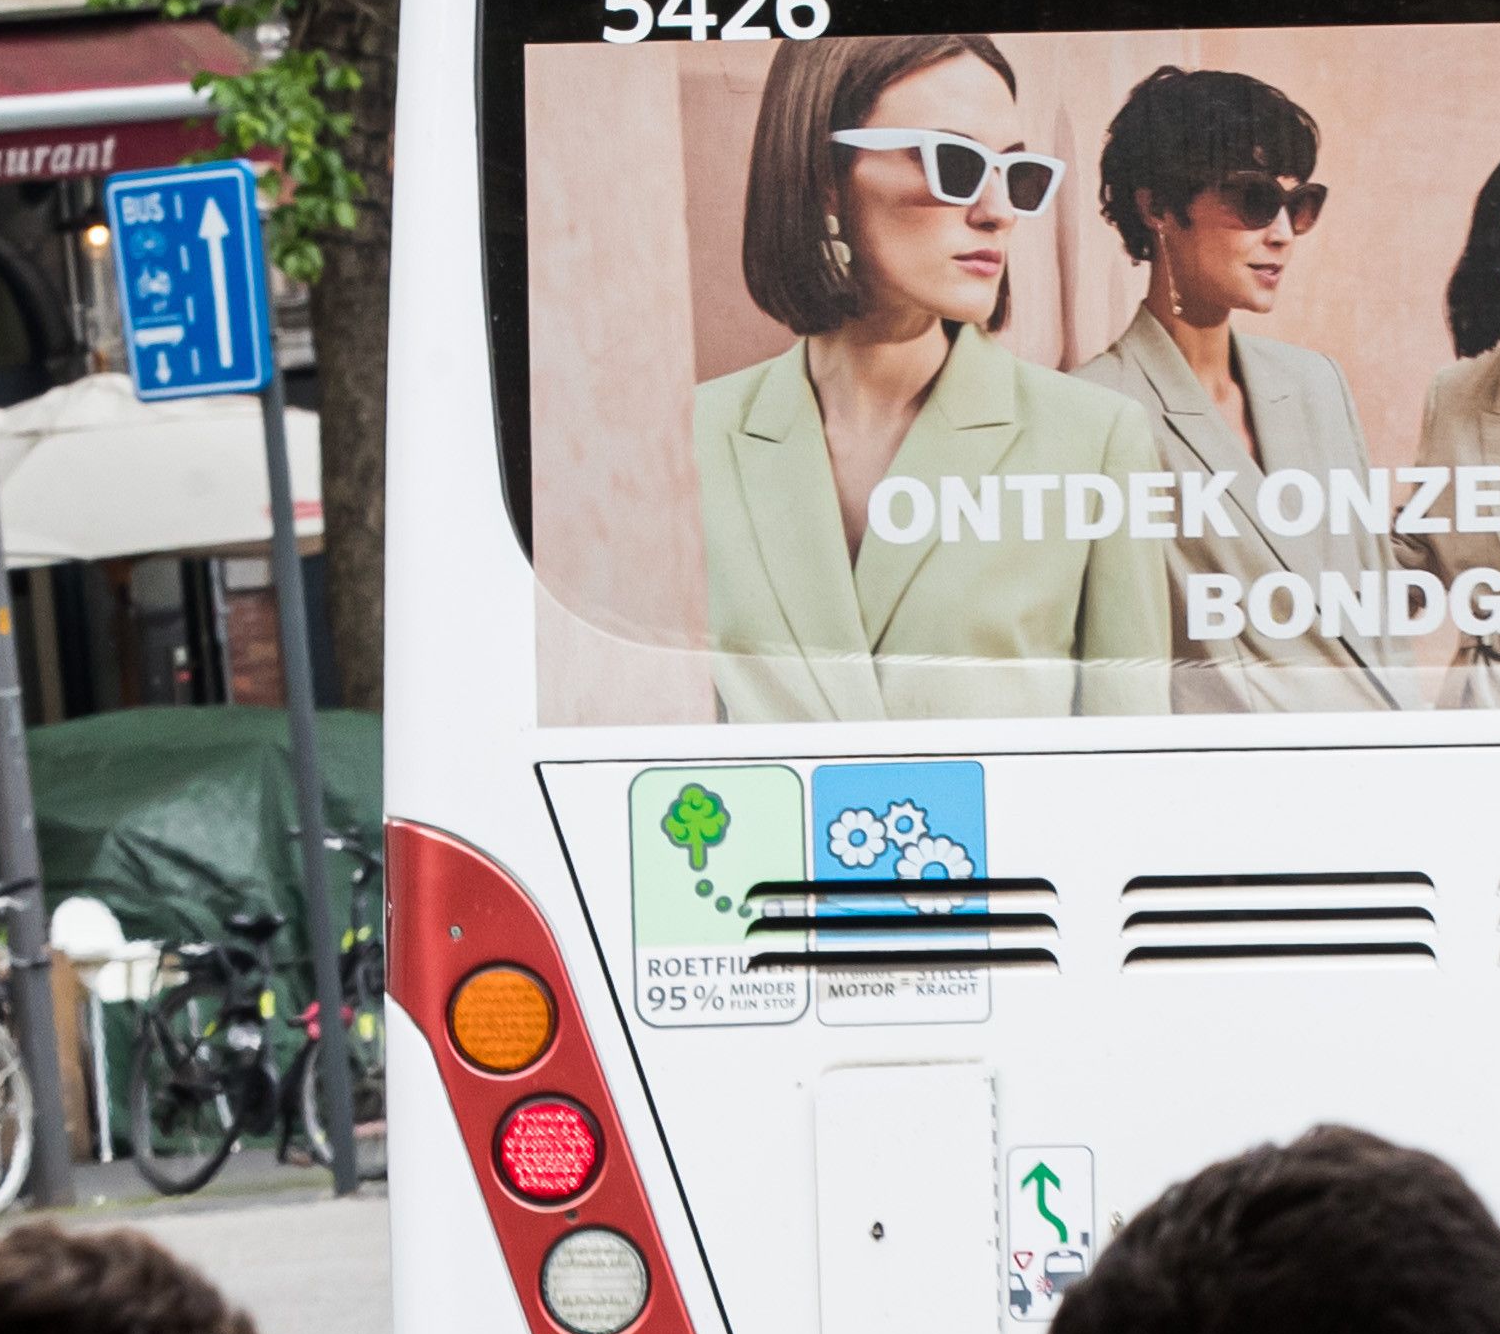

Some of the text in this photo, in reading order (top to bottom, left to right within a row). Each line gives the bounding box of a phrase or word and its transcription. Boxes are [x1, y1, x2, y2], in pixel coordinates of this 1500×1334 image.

[121, 192, 166, 225] BUS
[867, 469, 1241, 546] ONTDEK
[730, 982, 796, 996] MINDER
[828, 982, 896, 999] MOTOR
